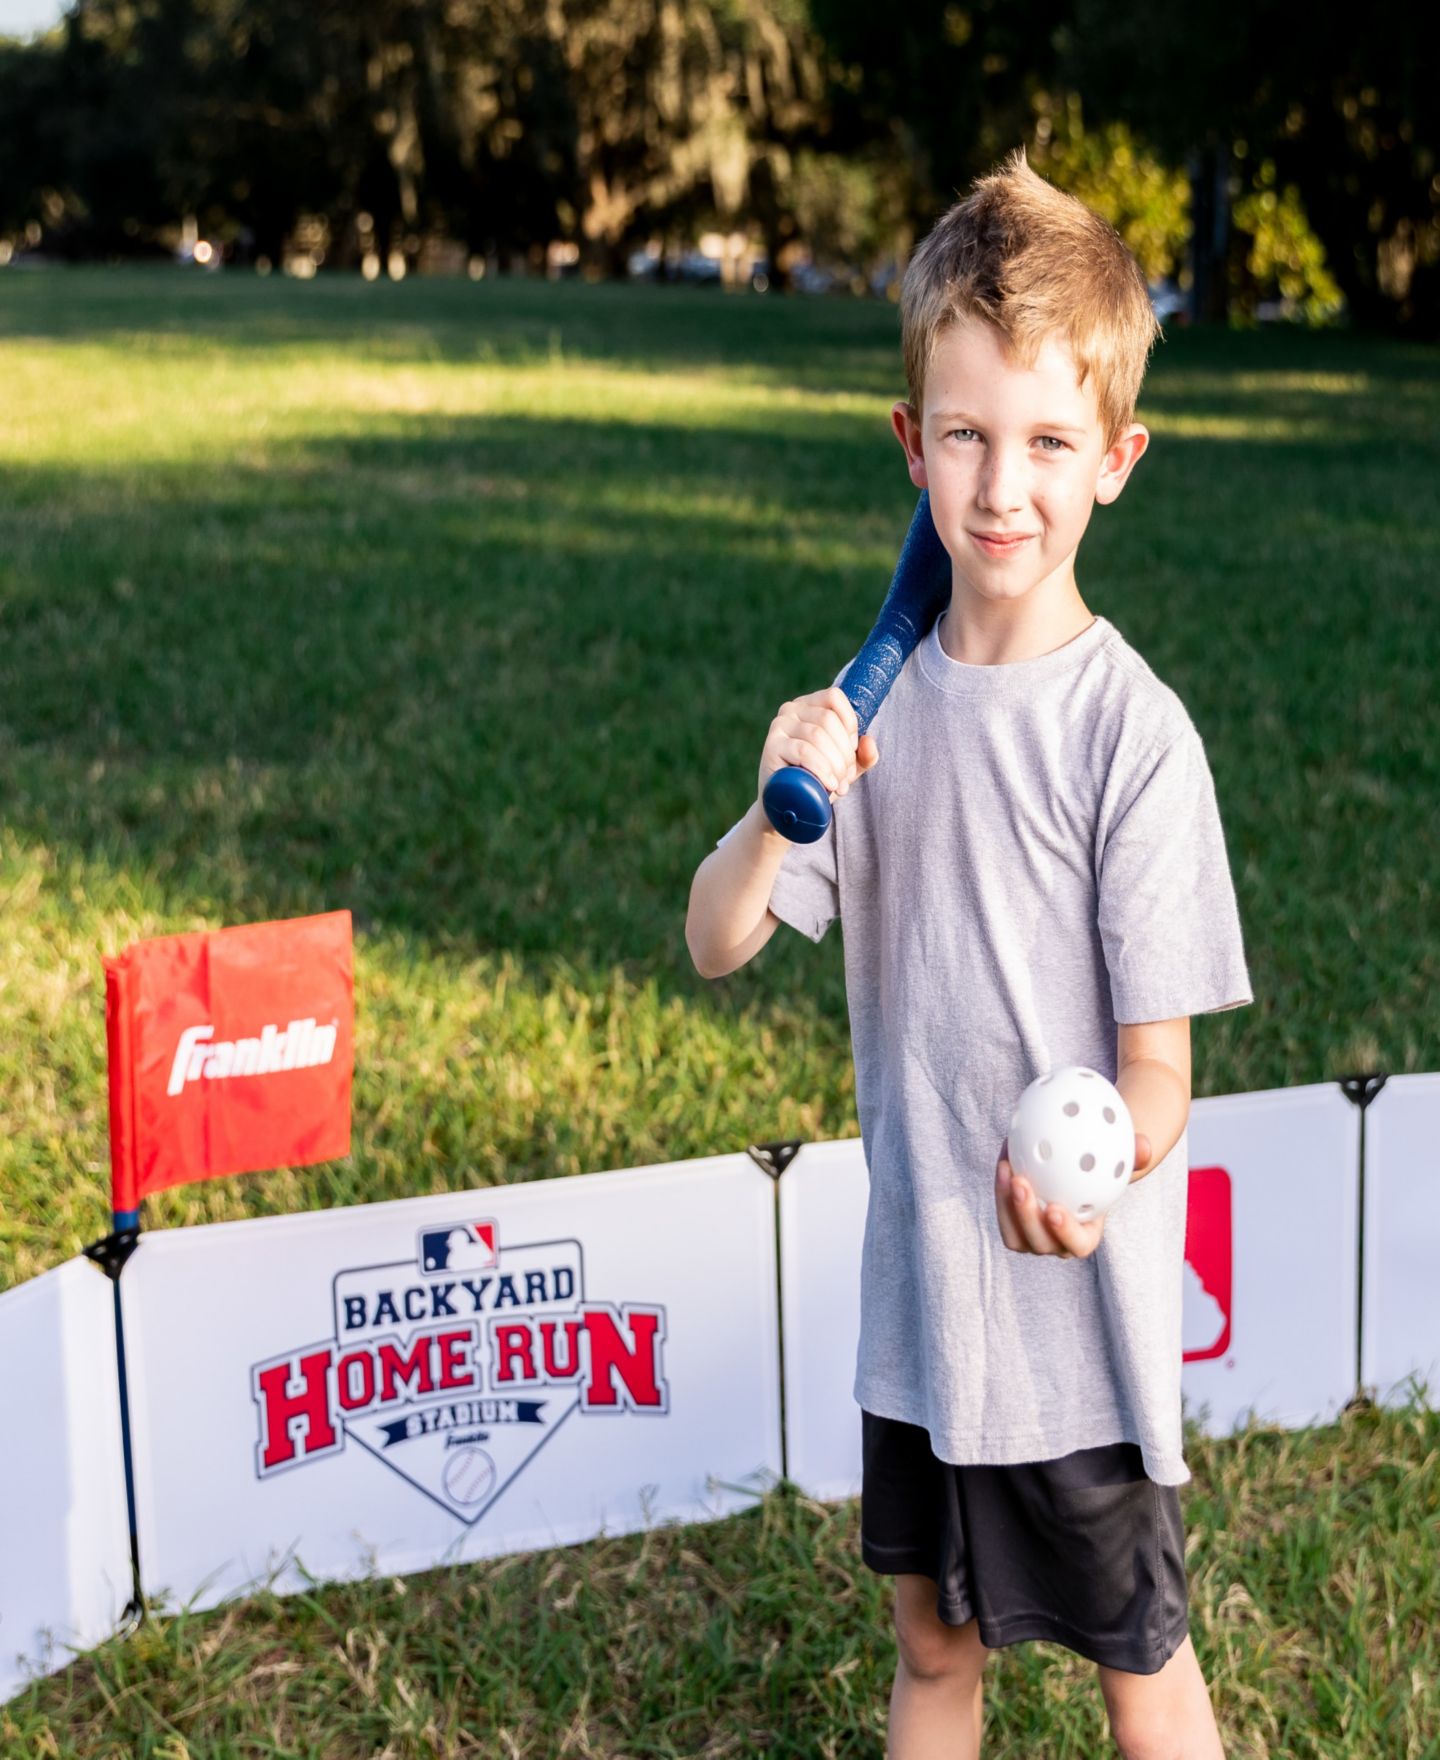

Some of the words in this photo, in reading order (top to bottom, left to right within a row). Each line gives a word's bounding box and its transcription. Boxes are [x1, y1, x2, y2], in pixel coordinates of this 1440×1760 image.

[343, 1266, 574, 1331] BACKYARD
[258, 1329, 475, 1470] HOME
[495, 1310, 662, 1408] RUN
[405, 1400, 519, 1438] STADIUM
